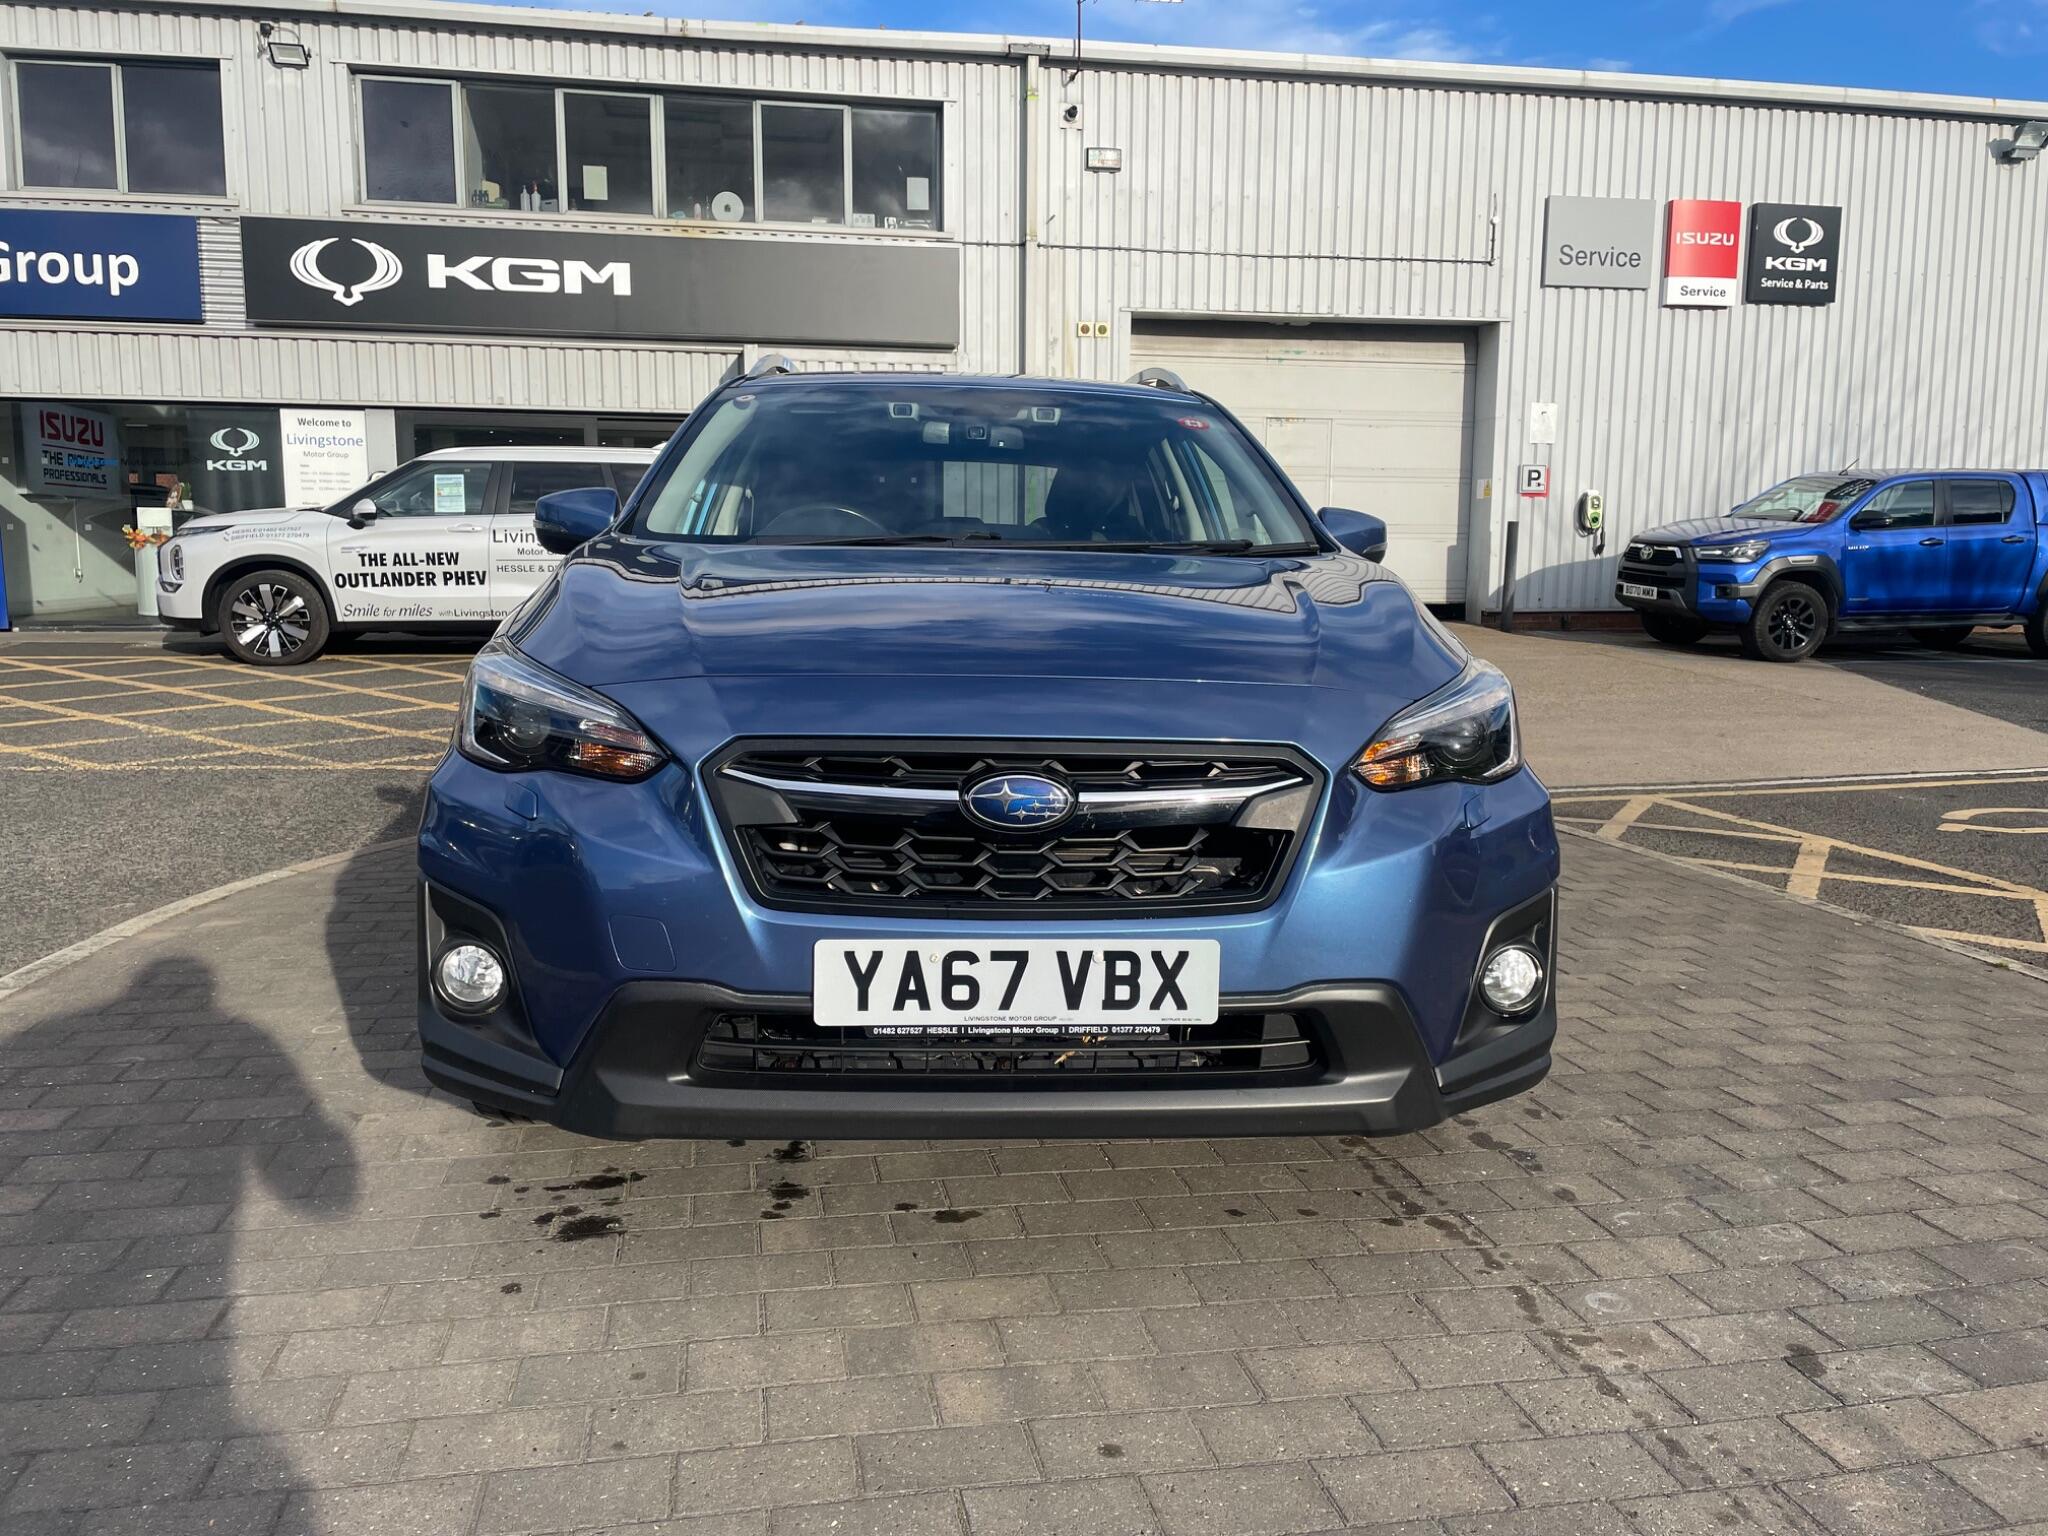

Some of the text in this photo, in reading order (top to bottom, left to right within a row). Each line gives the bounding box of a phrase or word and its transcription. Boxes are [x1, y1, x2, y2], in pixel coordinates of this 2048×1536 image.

[1675, 231, 1735, 246] ISUZU
[1559, 244, 1642, 268] Service
[1764, 256, 1828, 272] KGM
[427, 253, 632, 297] KGM
[1679, 285, 1727, 298] Service
[1761, 277, 1829, 290] Service & Parts
[39, 410, 104, 447] ISUZU
[297, 417, 352, 428] Welcome to
[286, 433, 364, 449] Livingstone
[42, 449, 64, 467] THE
[303, 450, 350, 460] Motor Group
[206, 459, 268, 471] KGM
[43, 467, 108, 485] PROFESSIONALS
[1527, 469, 1542, 488] P
[358, 552, 460, 567] THE ALL-NEW
[517, 547, 545, 556] Motor
[496, 564, 536, 573] HESSLE
[334, 570, 488, 589] OUTLANDER PHEV
[343, 603, 381, 618] Smile
[383, 606, 397, 618] for
[398, 604, 433, 617] miles
[453, 608, 511, 620] Livingston
[843, 950, 1190, 1012] YA67 VBX
[873, 1026, 1161, 1036] 01482 627527 HESSLE Livingstone Motor Group DRIFFIELD 01377 270479
